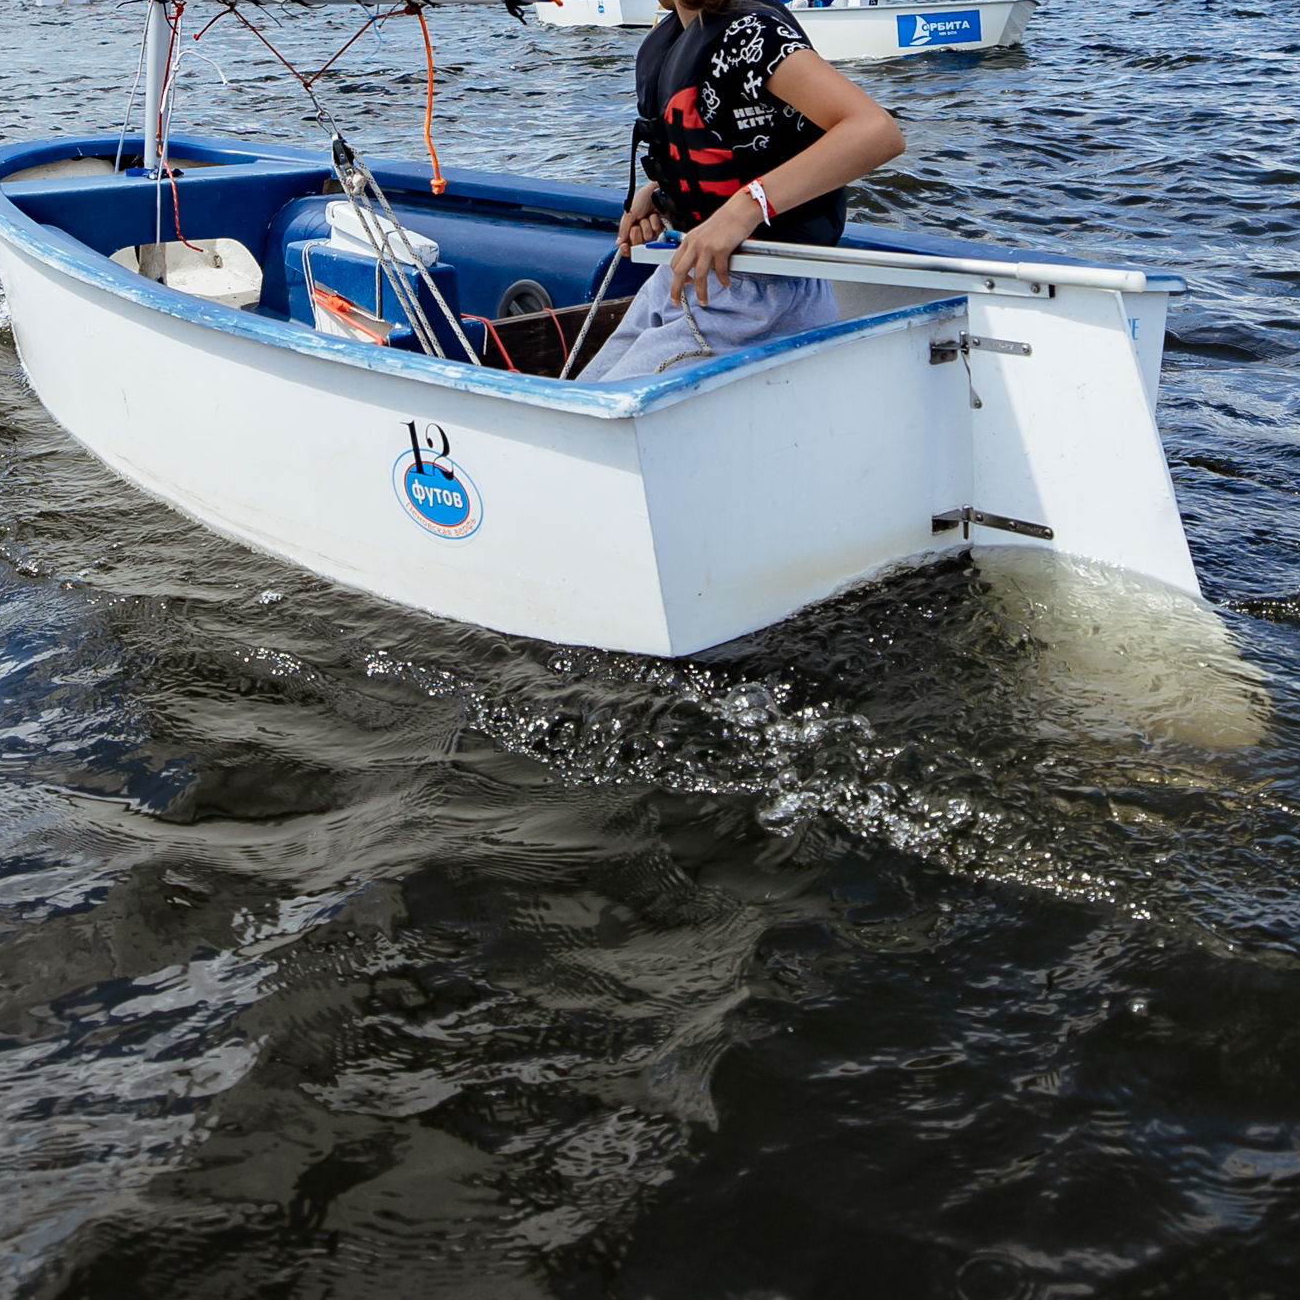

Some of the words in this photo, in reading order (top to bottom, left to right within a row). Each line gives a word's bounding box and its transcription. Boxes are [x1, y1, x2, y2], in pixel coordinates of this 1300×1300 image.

[921, 20, 970, 32] ОРБИТА
[400, 419, 454, 482] 12
[411, 478, 464, 509] футов
